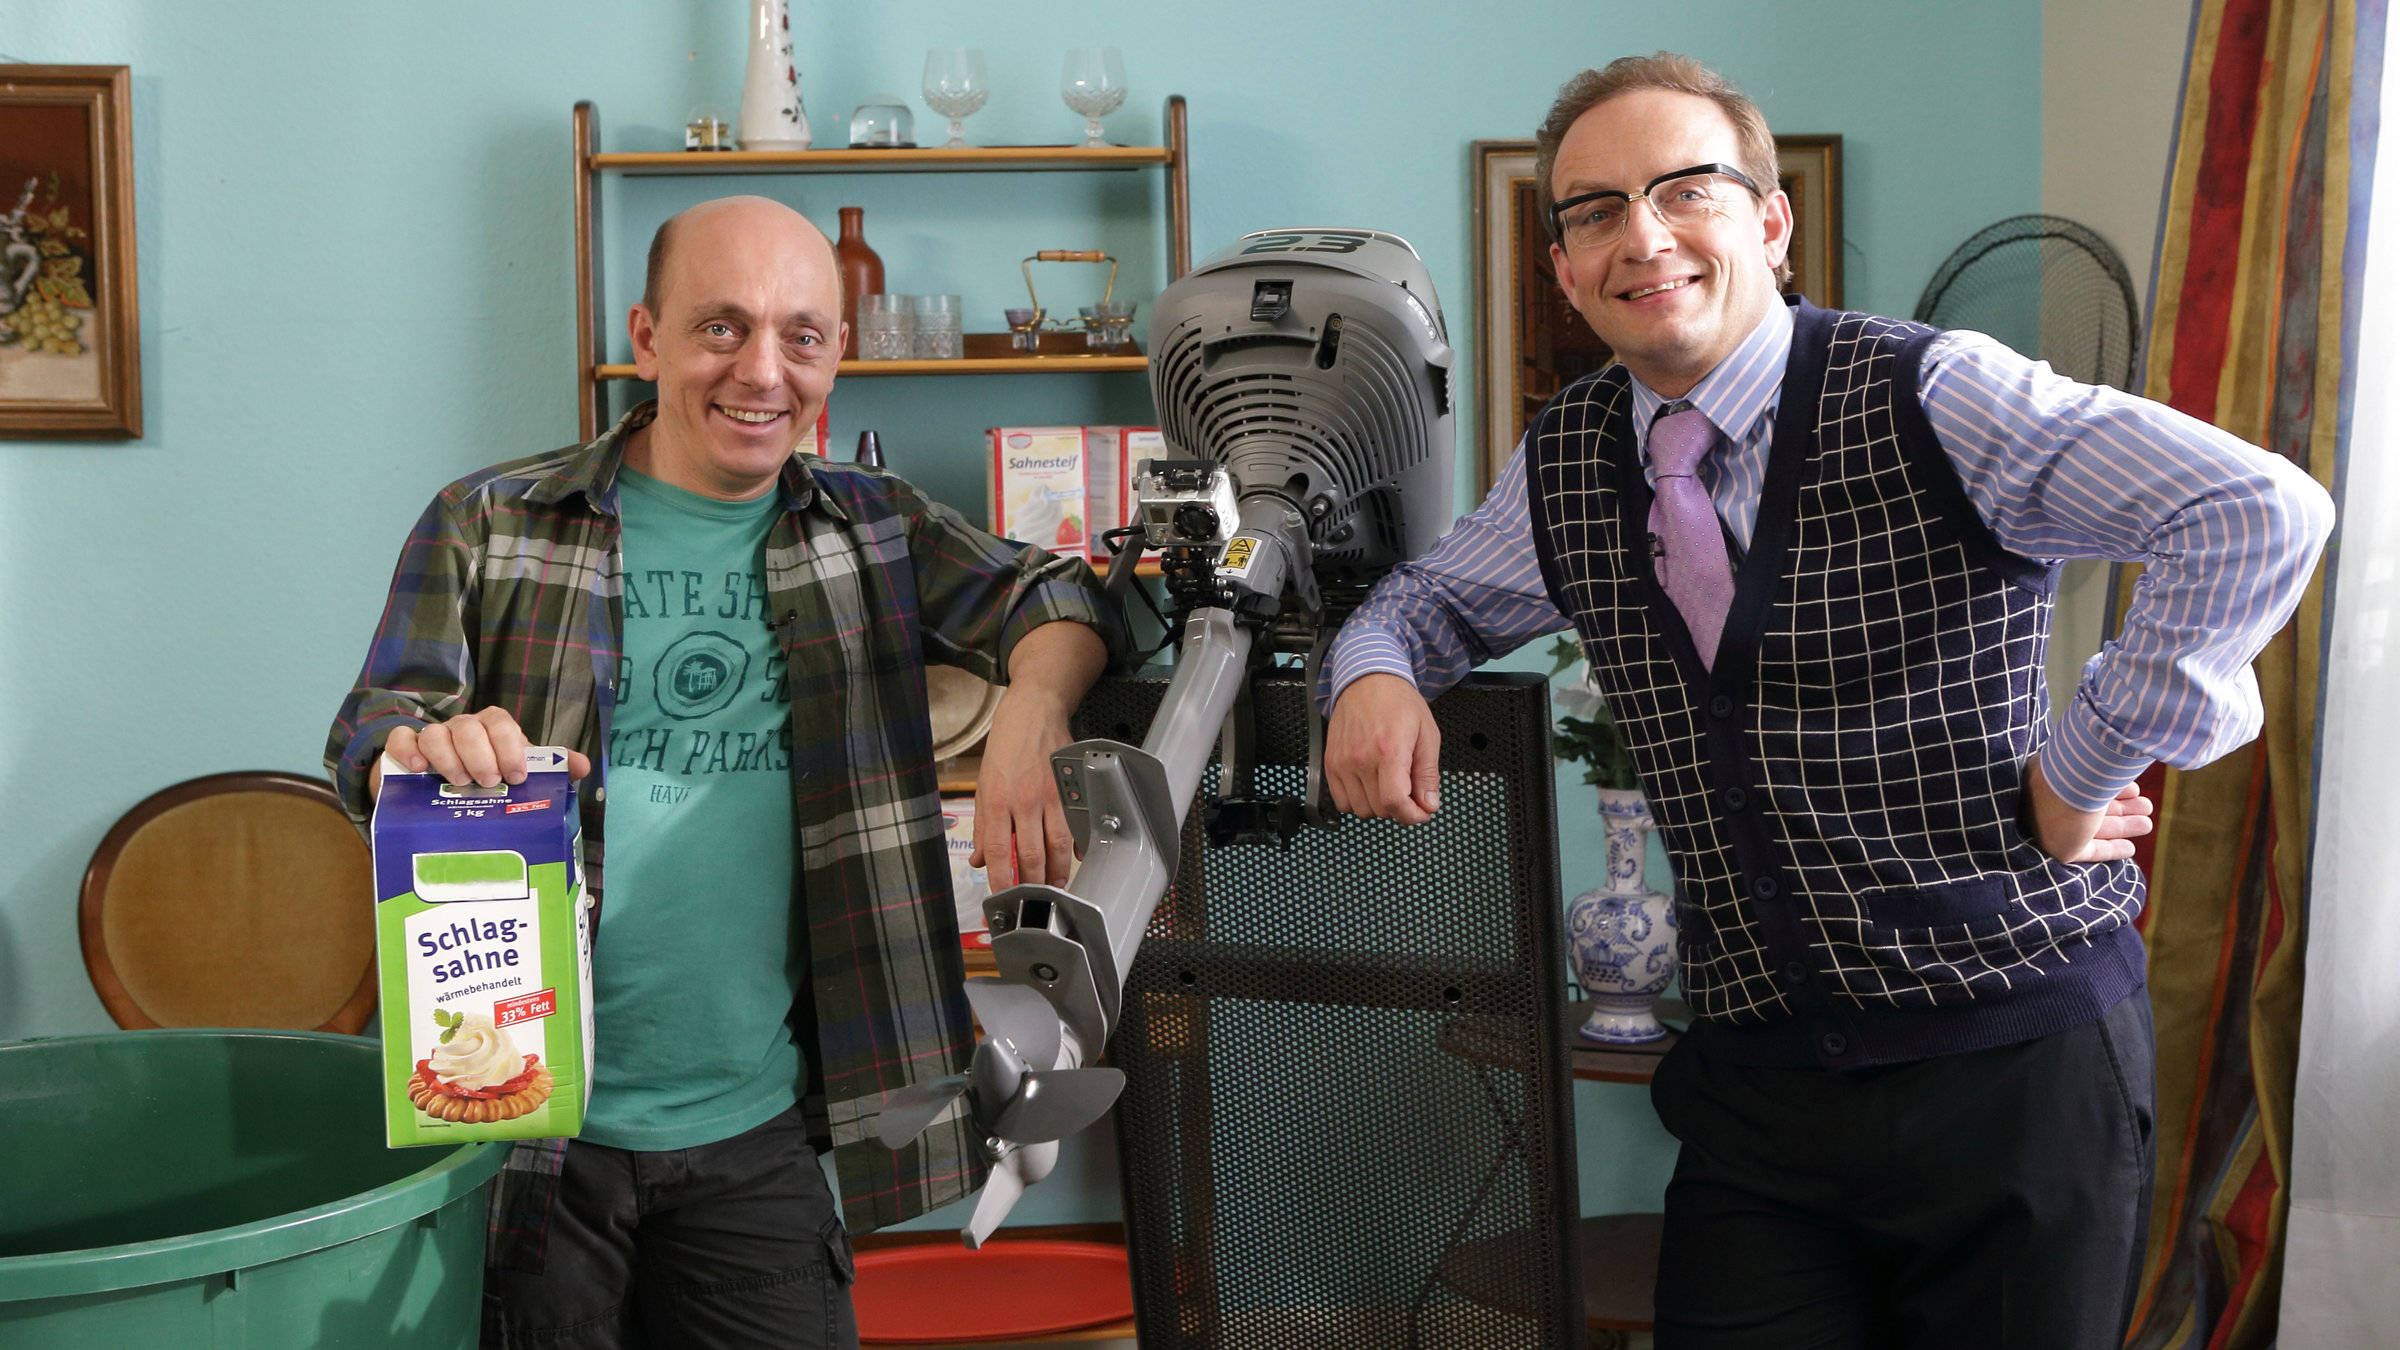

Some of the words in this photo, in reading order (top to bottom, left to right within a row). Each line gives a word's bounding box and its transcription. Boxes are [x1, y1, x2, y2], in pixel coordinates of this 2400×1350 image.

[1009, 455, 1078, 471] Sahnesteif
[430, 798, 513, 806] Schlagsahne
[453, 810, 463, 818] 5
[466, 809, 486, 817] kg
[417, 917, 528, 957] Schlag-
[432, 948, 519, 984] sahne
[436, 976, 522, 1003] wärmebehandelt
[507, 996, 540, 1008] mindestens
[501, 1007, 526, 1024] 33%
[530, 1001, 550, 1014] Fett
